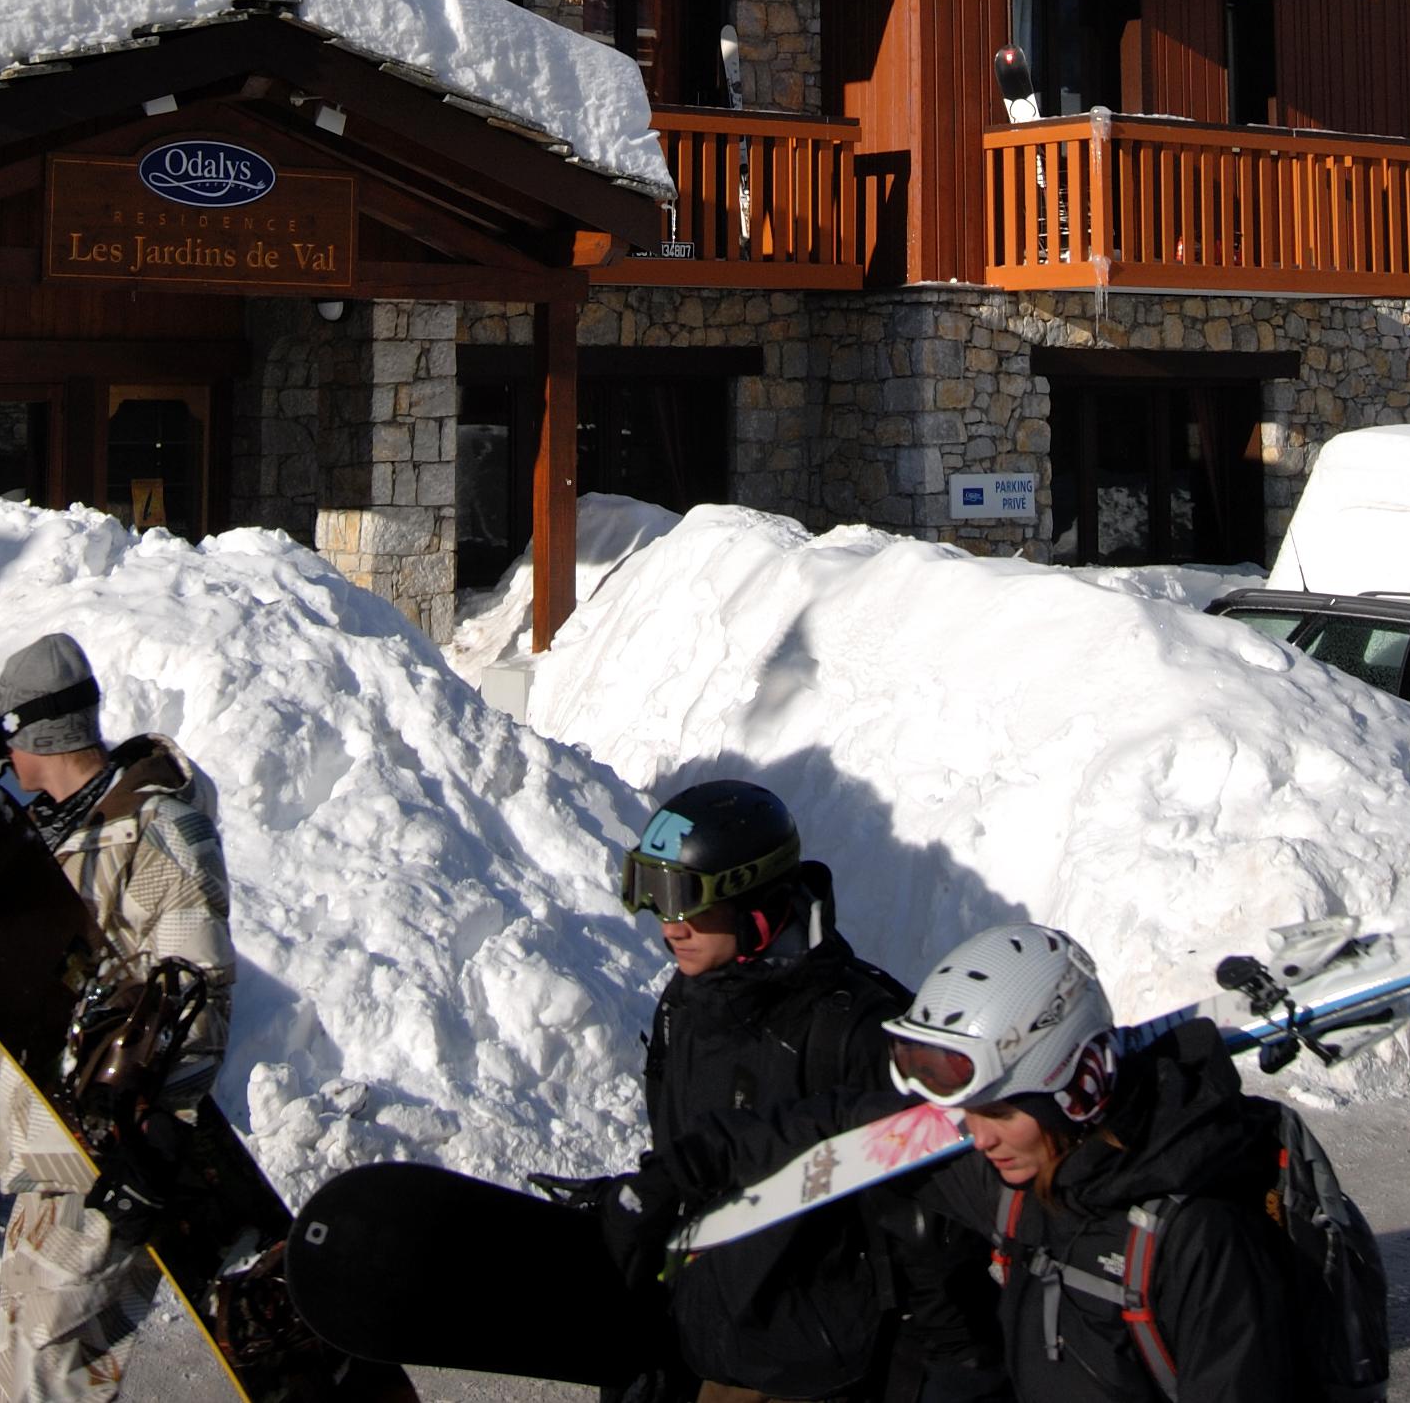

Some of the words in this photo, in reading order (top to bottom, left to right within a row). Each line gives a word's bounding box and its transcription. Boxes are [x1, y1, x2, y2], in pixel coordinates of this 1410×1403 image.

[164, 148, 252, 182] Odalys
[69, 232, 124, 263] Les
[129, 233, 237, 273] Jardins
[246, 241, 280, 270] de
[292, 243, 336, 272] Val
[995, 481, 1032, 493] PARKING
